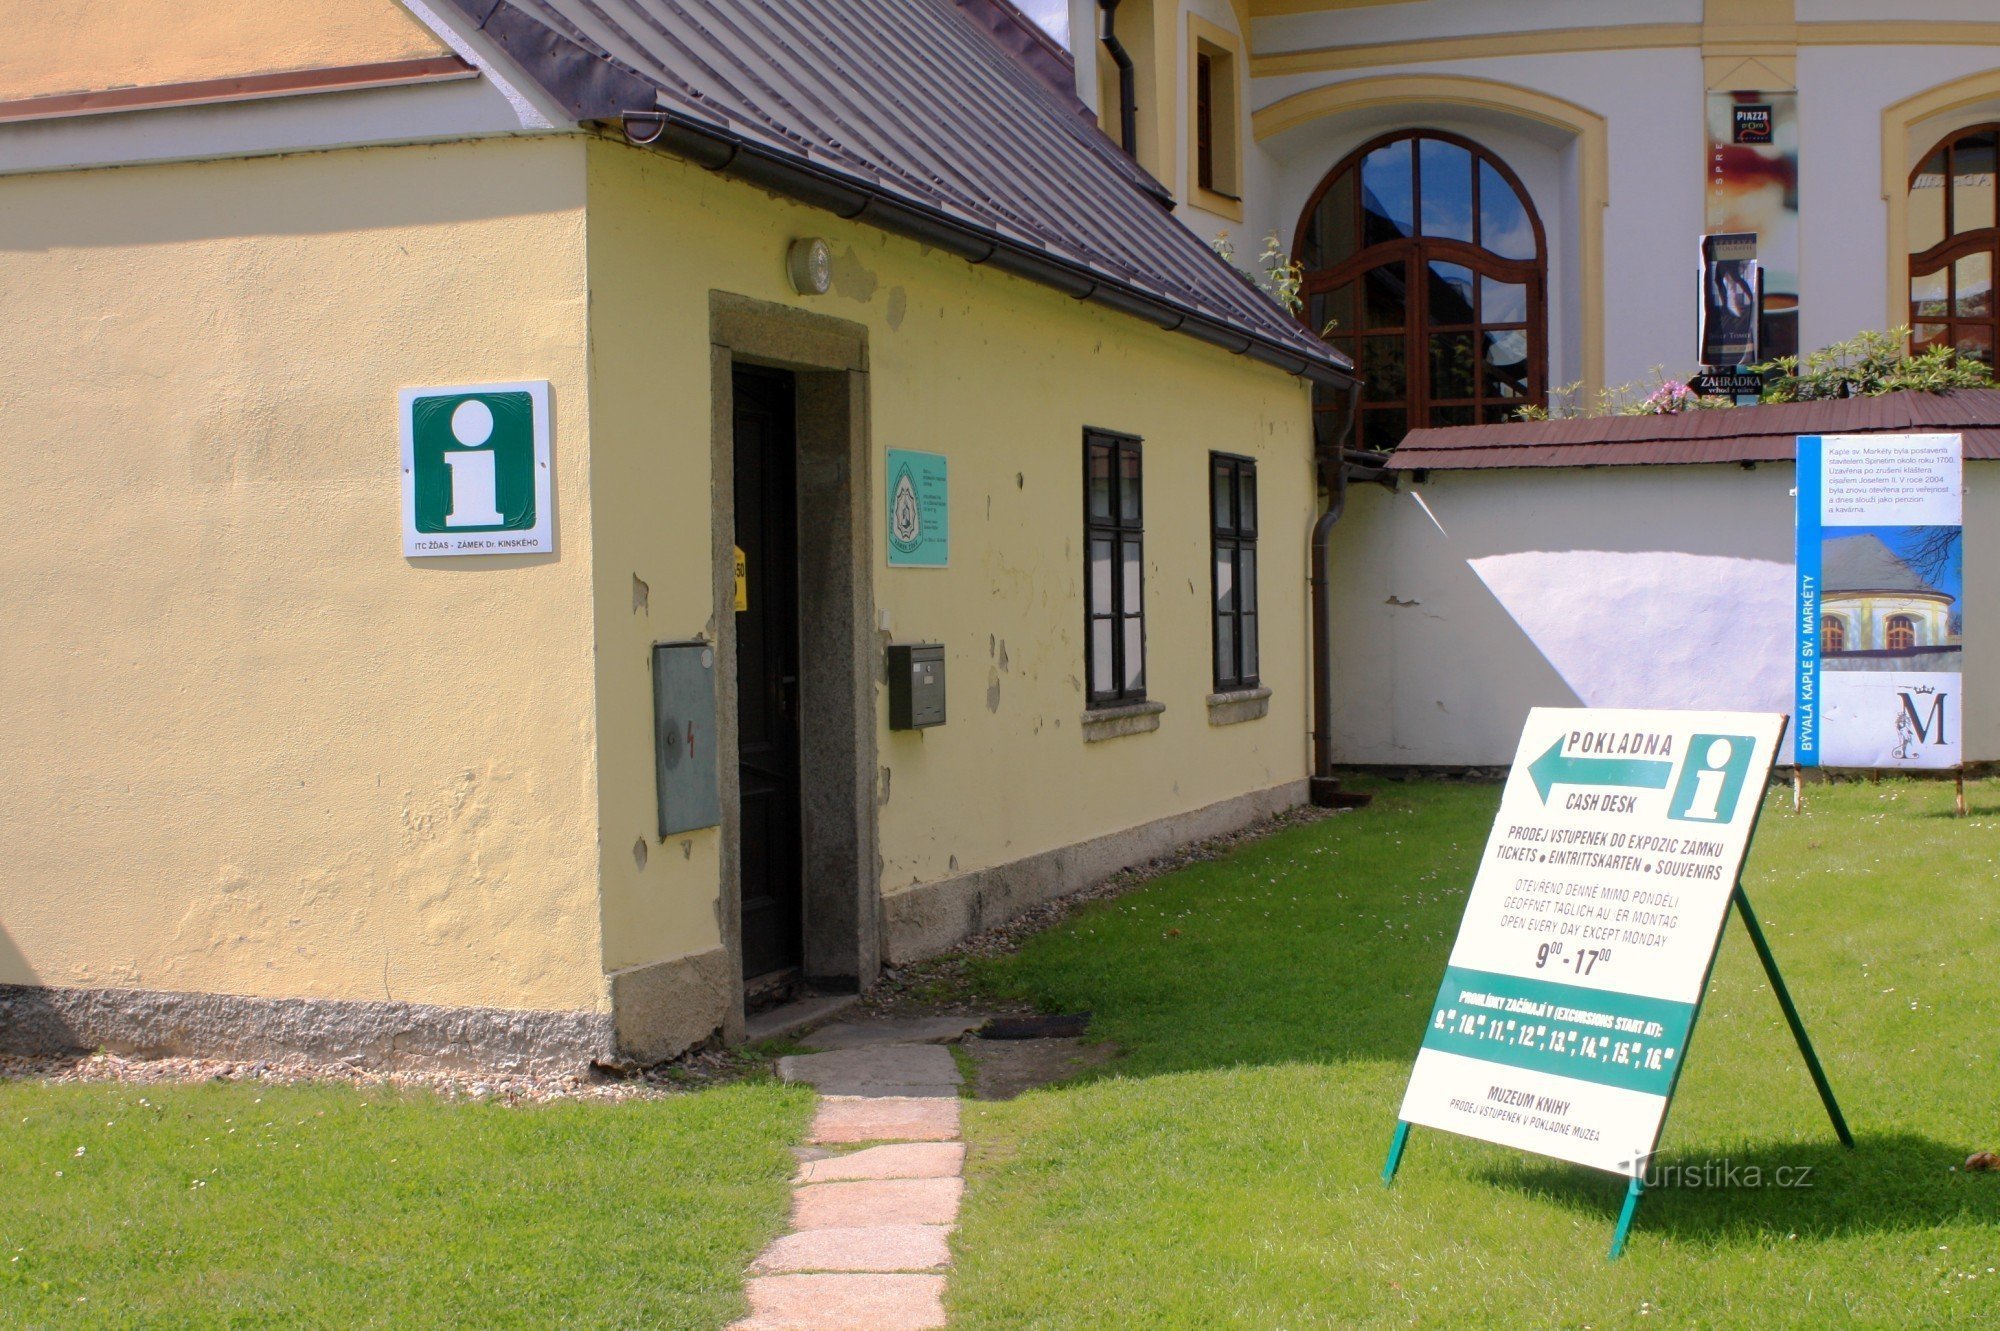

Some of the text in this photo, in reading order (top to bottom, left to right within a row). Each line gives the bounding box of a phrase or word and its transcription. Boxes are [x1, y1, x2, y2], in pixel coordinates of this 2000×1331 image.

[1736, 112, 1768, 120] PIAZZA
[1701, 374, 1761, 386] ZAHRÁDKA
[1863, 448, 1891, 456] Markéty
[1877, 496, 1892, 504] jako
[1895, 496, 1923, 504] penzion
[1916, 486, 1949, 494] veřejnost
[415, 542, 426, 550] ITC
[428, 541, 449, 549] ŽĎAS
[457, 540, 484, 548] ZÁMEK
[498, 538, 539, 548] KINSKÉHO
[1799, 575, 1814, 750] BÝVALÁ KAPLE SV. MARKÉTY
[1568, 732, 1672, 756] POKLADNA
[1566, 793, 1637, 813] CASH DESK
[1508, 826, 1548, 842] PRODEJ
[1550, 829, 1608, 847] VSTUPENEK
[1610, 833, 1626, 848] DO
[1628, 835, 1679, 853] EXPOZIC
[1497, 845, 1722, 880] TICKETS EINTRITTSKARTEN SOUVENIRS
[1600, 888, 1629, 902] MIMO
[1632, 911, 1678, 928] MONTAG
[1500, 915, 1668, 948] OPEN EVERY DAY EXCEPT MONDAY
[1545, 1006, 1553, 1018] V
[1614, 1017, 1644, 1034] START
[1487, 1085, 1571, 1116] MUZEUM KNIHY
[1450, 1099, 1478, 1114] PRODEJ
[1479, 1105, 1520, 1124] VSTUPENEK
[1523, 1114, 1529, 1125] V
[1572, 1124, 1600, 1141] MUZEA
